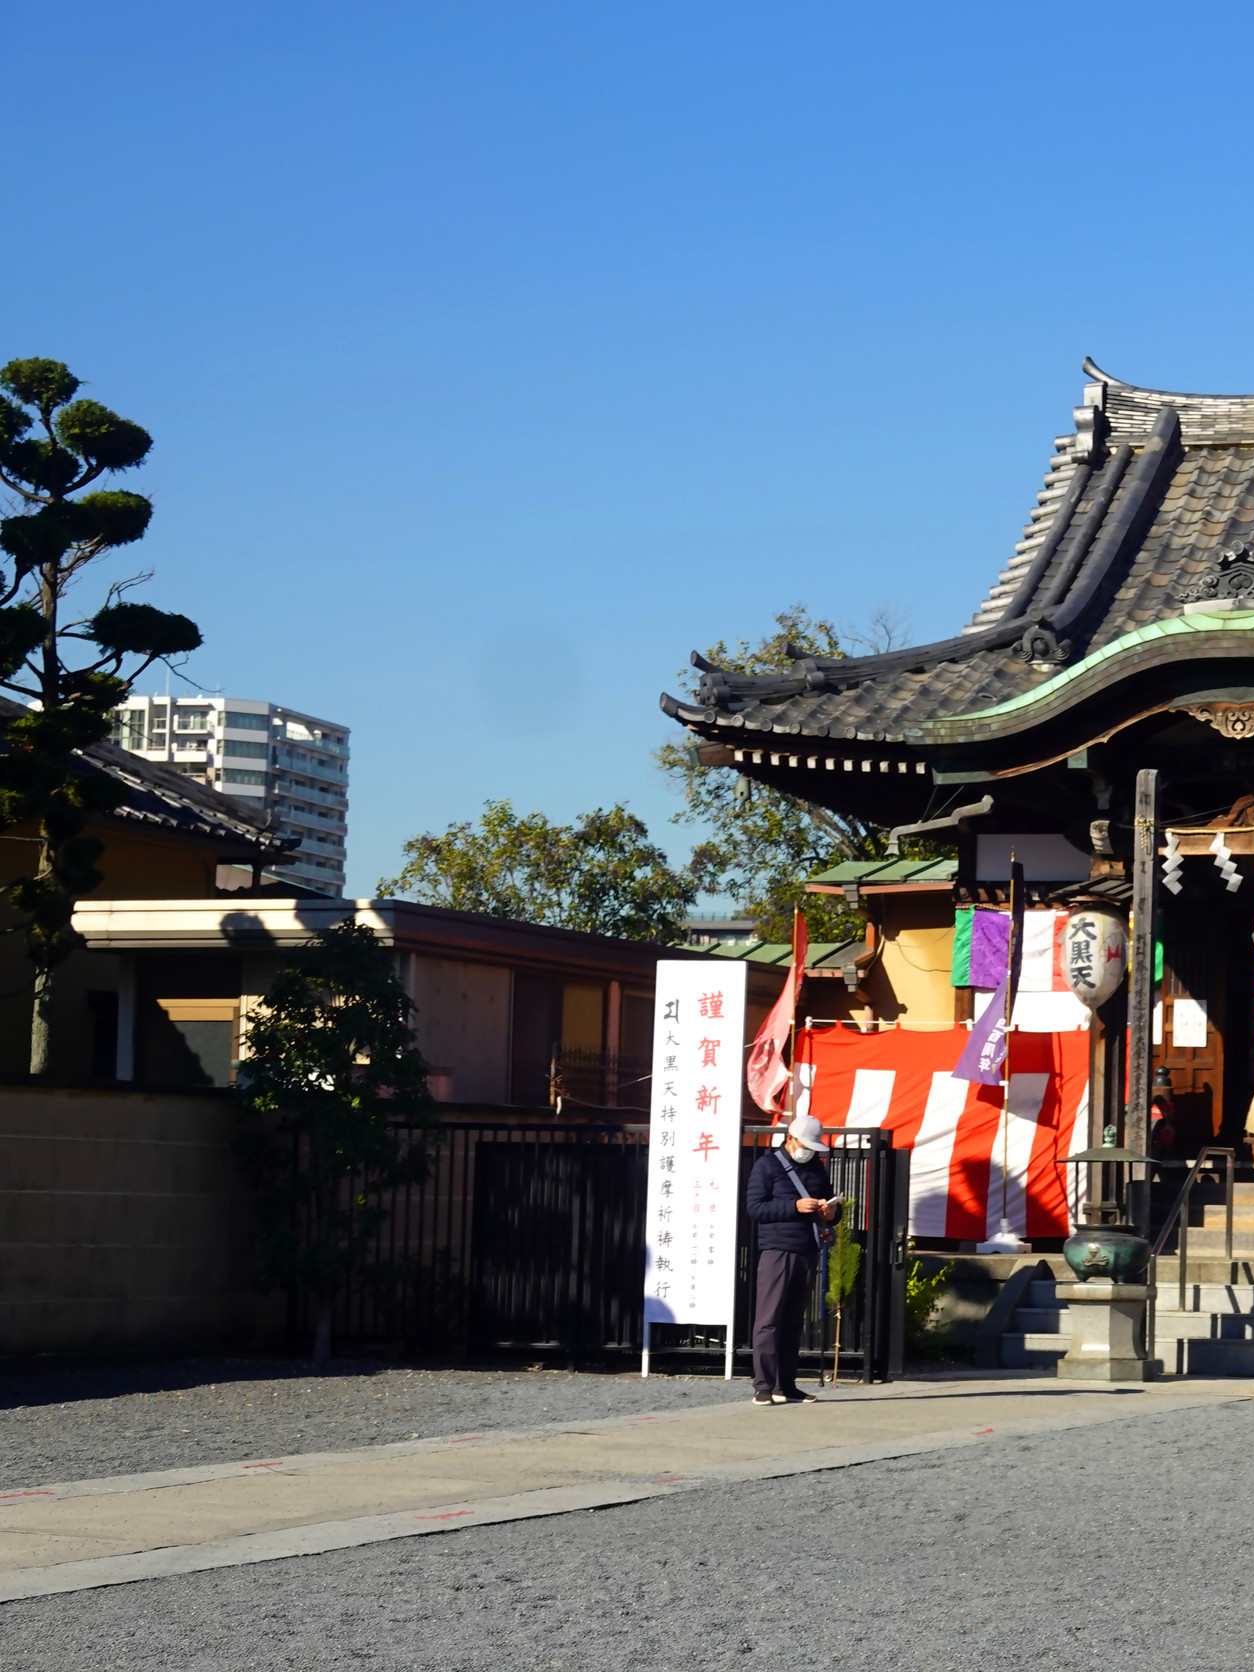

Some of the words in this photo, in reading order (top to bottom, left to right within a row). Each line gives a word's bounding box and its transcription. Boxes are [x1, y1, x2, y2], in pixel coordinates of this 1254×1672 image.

[1069, 917, 1097, 990] 大黒天
[692, 990, 725, 1163] 謹賀新年
